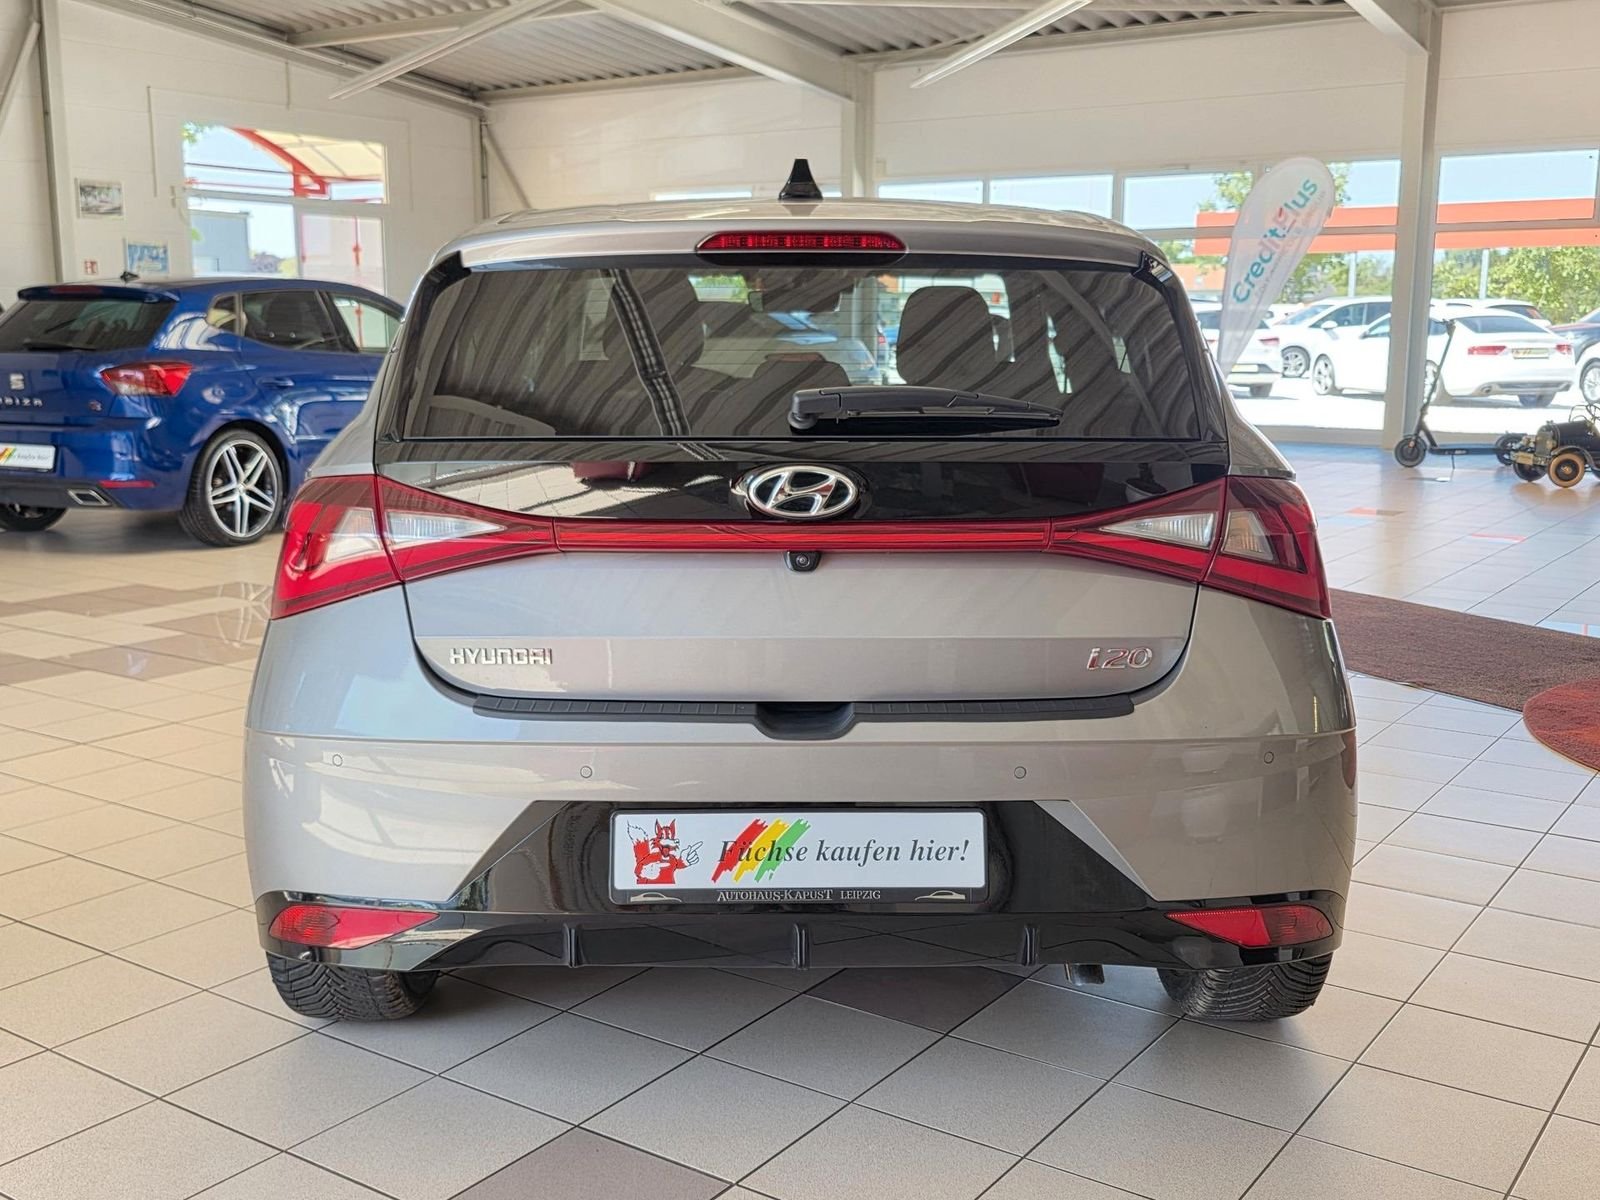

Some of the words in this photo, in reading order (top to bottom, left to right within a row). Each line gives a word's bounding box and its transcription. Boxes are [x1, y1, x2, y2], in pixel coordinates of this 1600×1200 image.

[449, 647, 552, 665] HYUNDAI
[1087, 647, 1153, 670] i20
[718, 838, 808, 862] Füchse
[815, 839, 901, 867] kaufen
[909, 839, 970, 862] hier!
[840, 889, 881, 900] LEIPZIG
